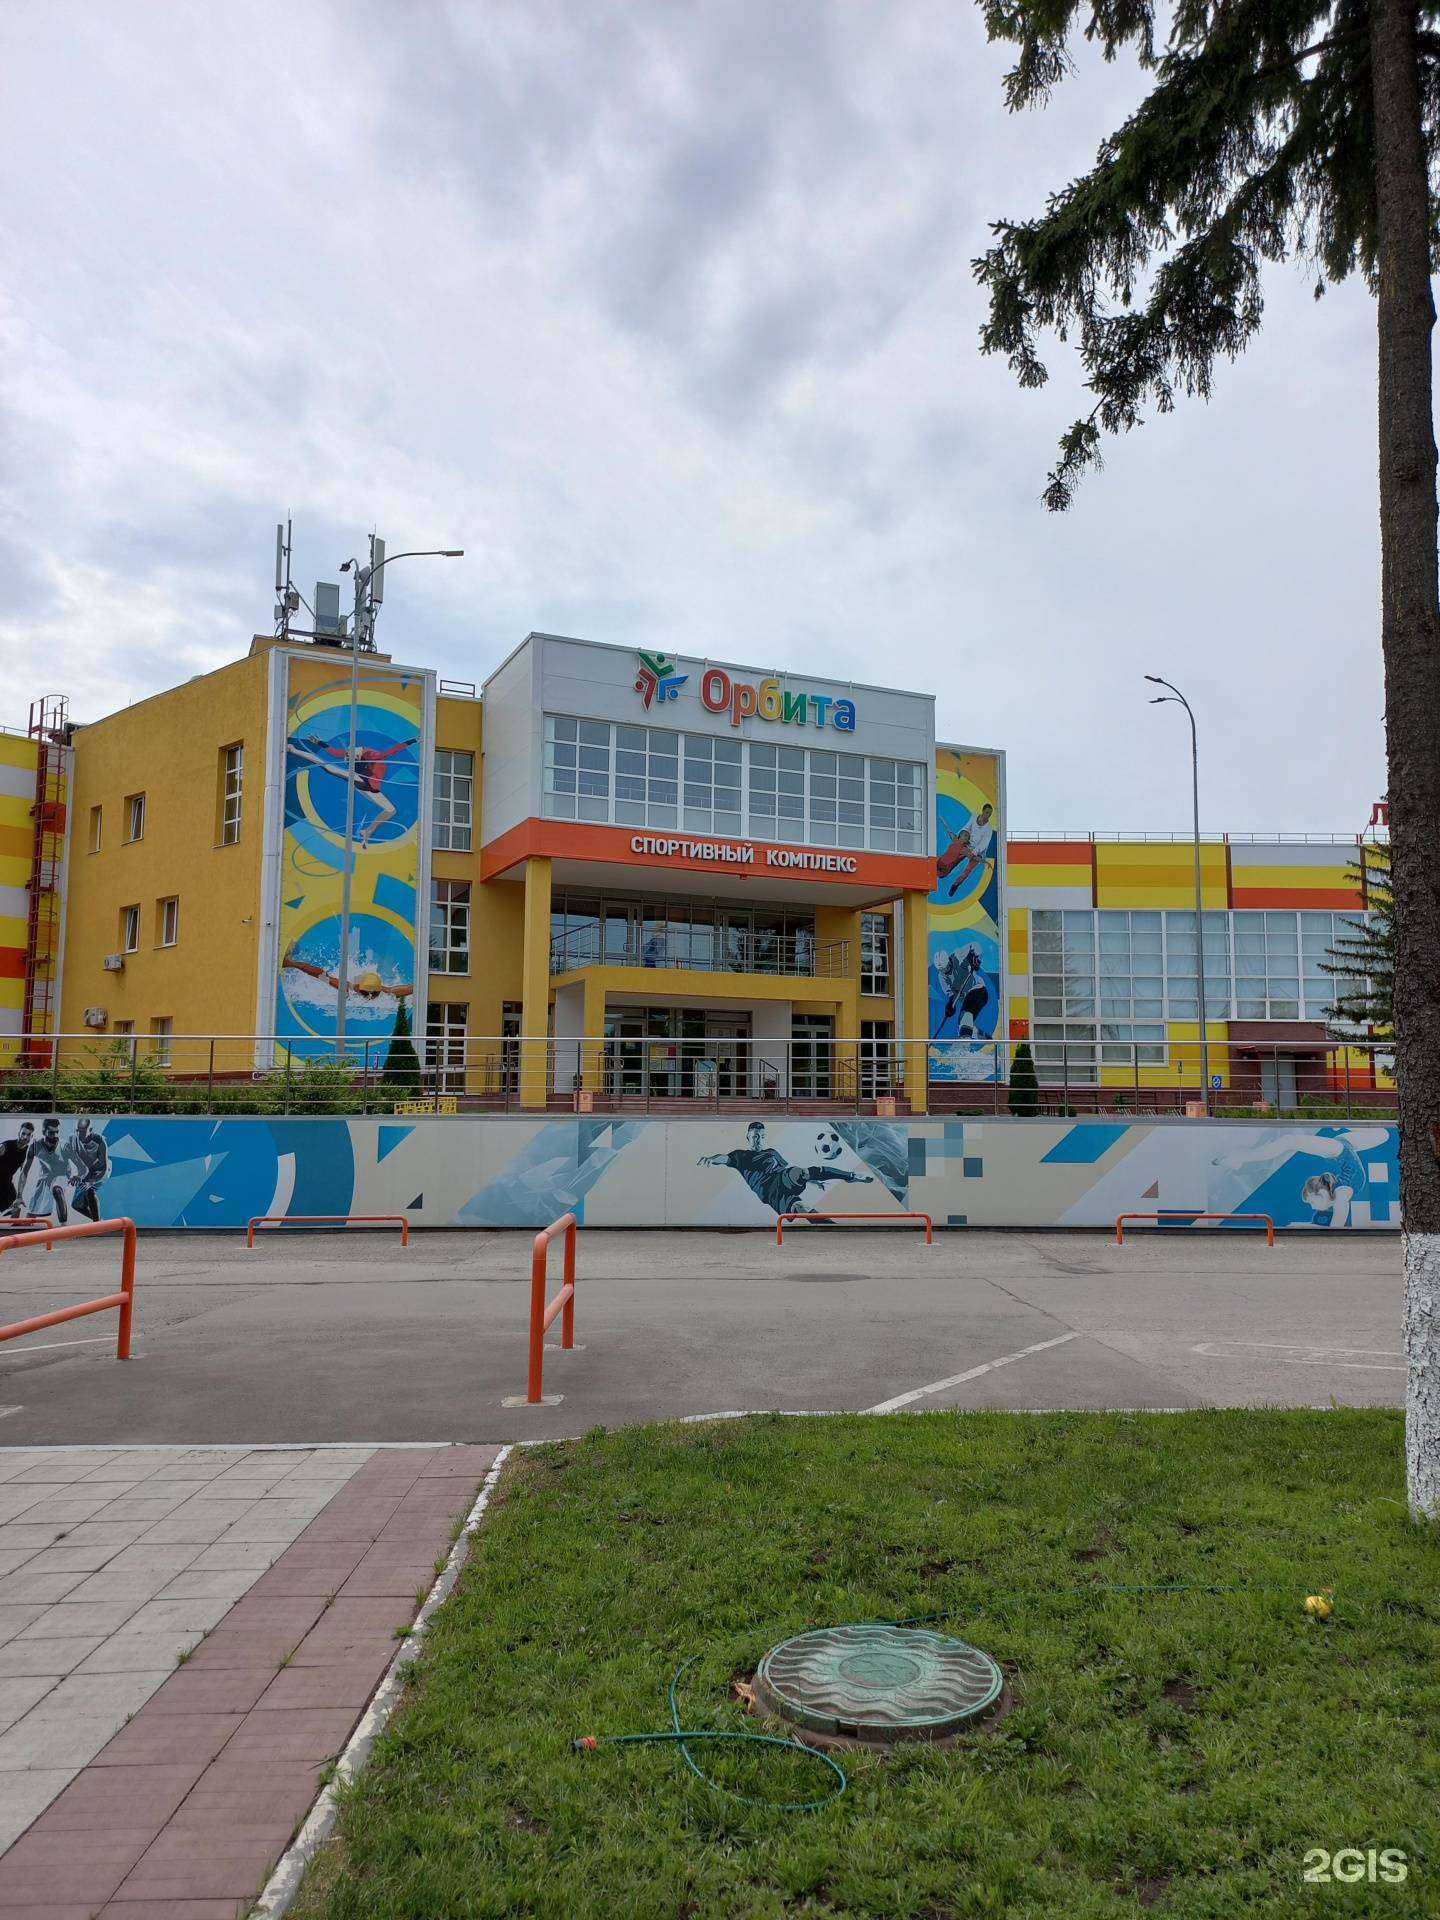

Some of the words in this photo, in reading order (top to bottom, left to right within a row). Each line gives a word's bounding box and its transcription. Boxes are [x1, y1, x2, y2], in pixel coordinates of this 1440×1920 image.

[701, 669, 856, 731] Орбита
[631, 836, 754, 863] СПОРТИВНЫЙ
[766, 849, 858, 873] КОМПЛЕКС
